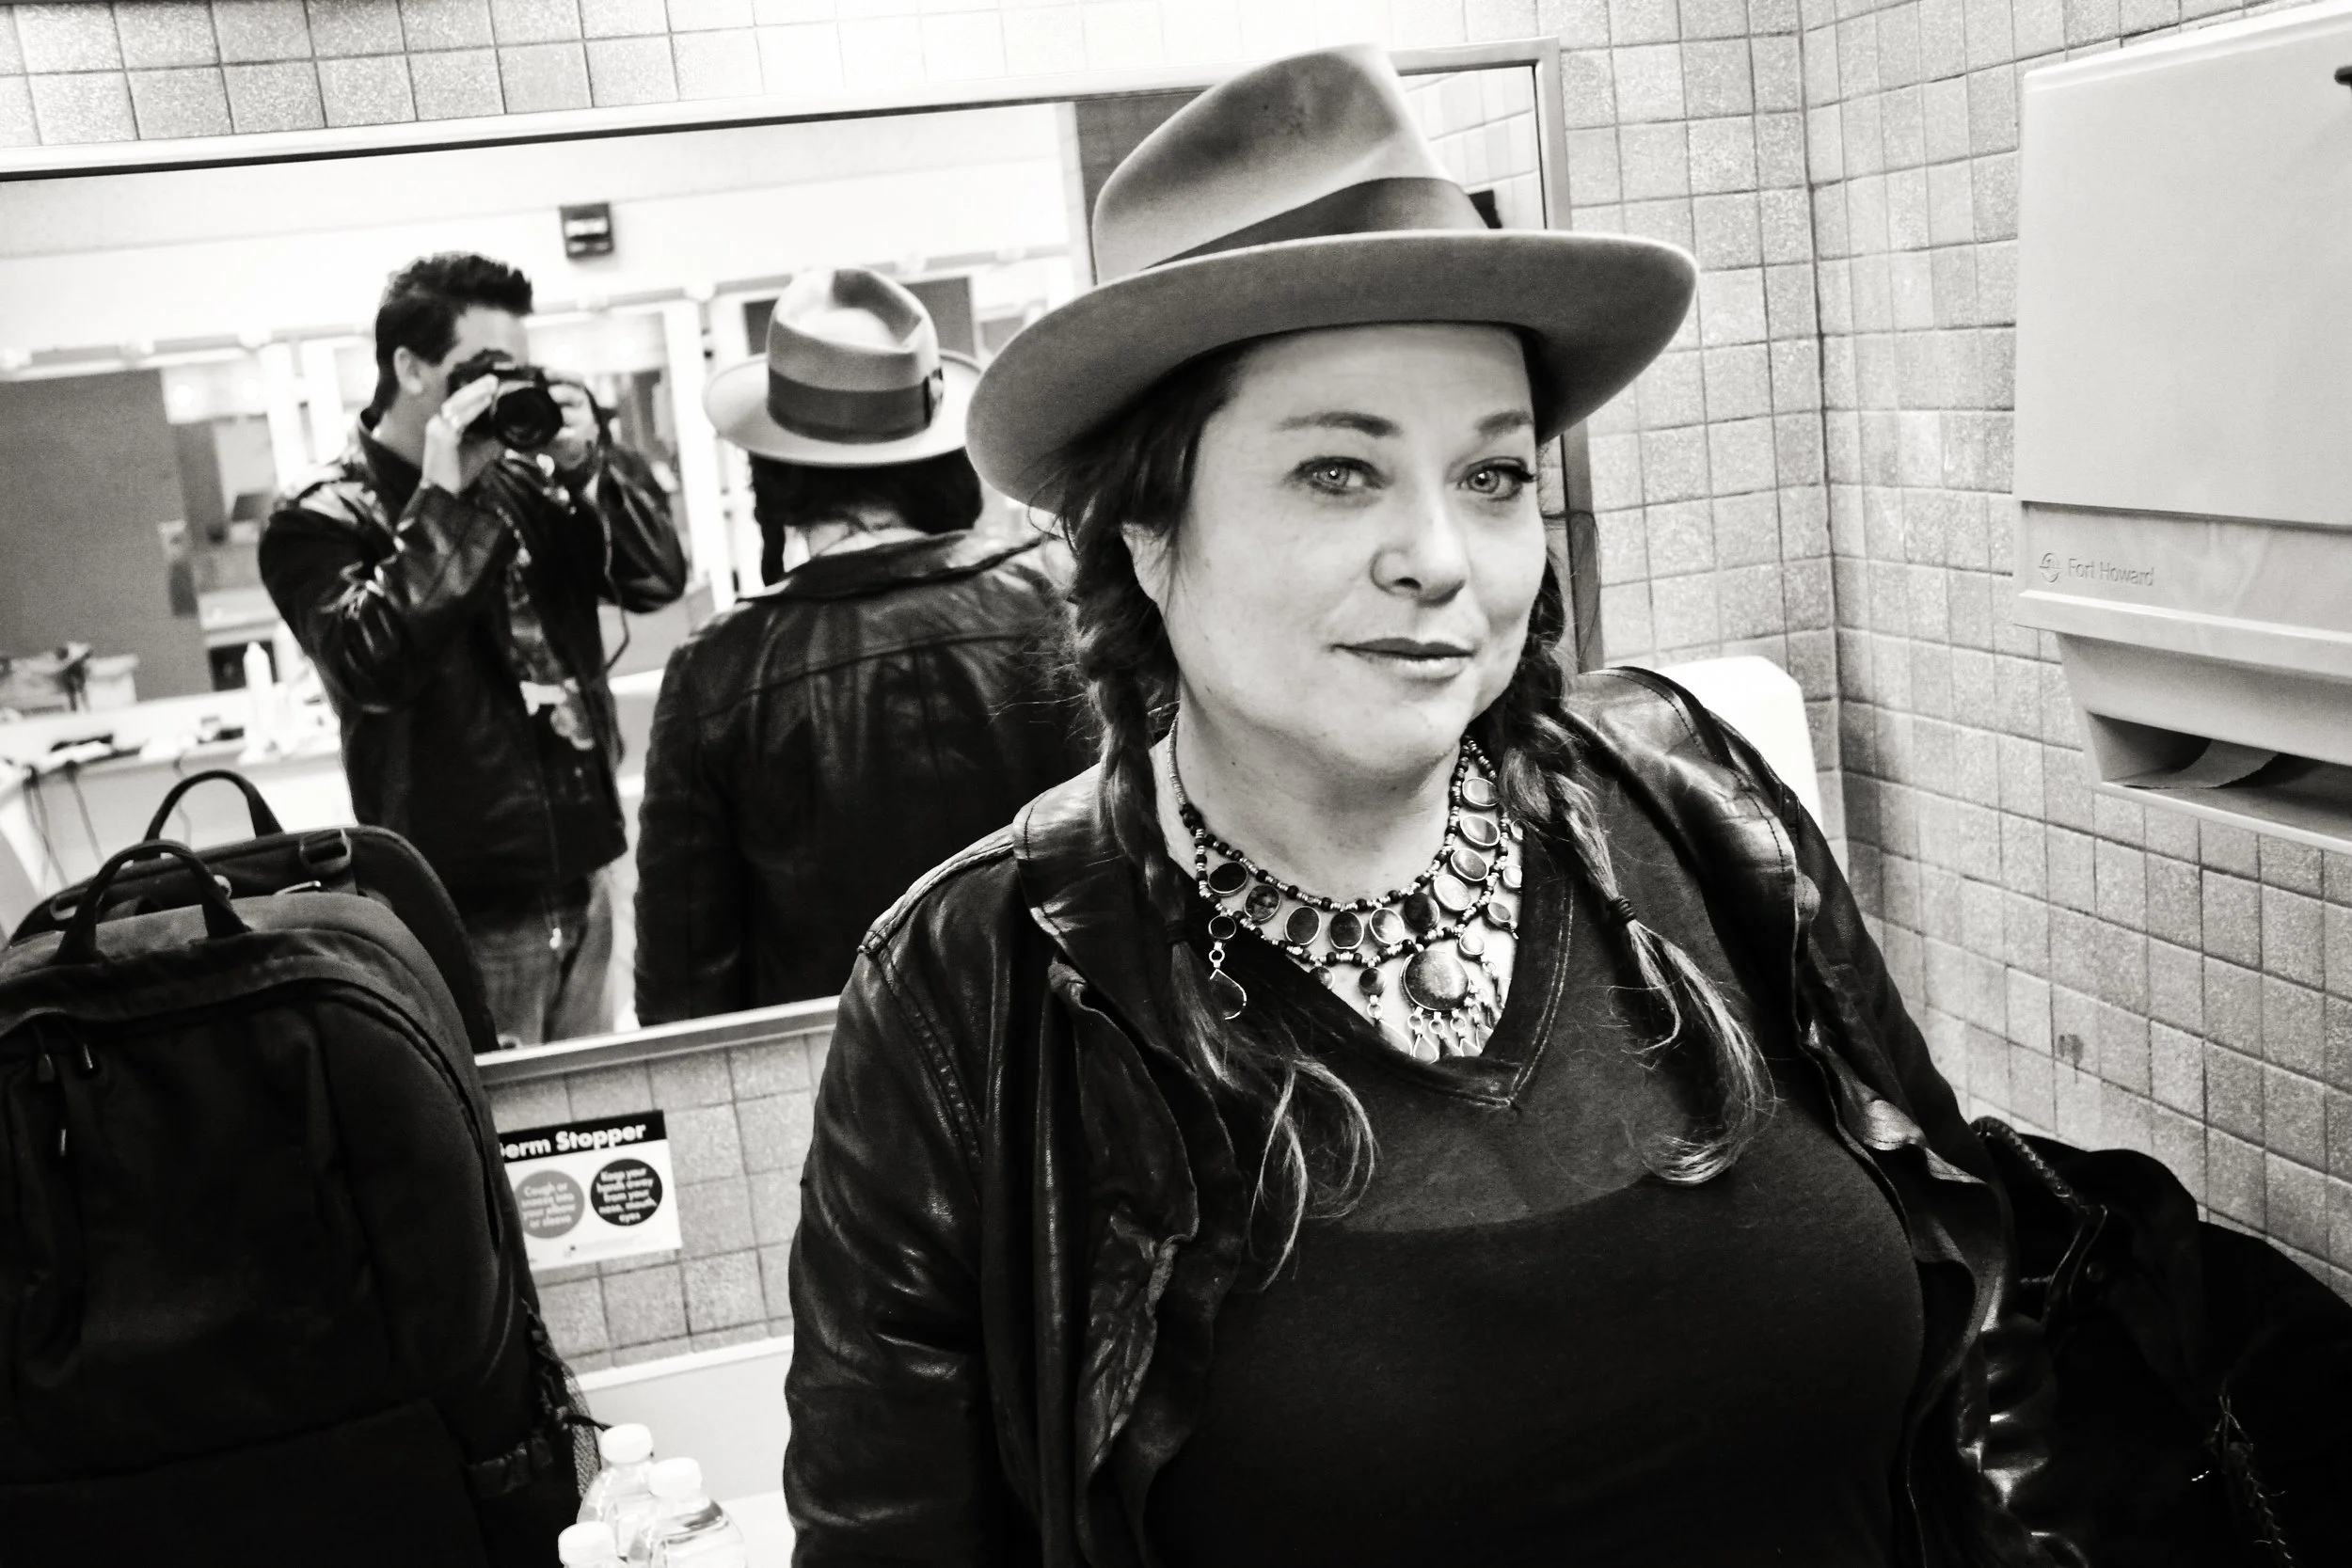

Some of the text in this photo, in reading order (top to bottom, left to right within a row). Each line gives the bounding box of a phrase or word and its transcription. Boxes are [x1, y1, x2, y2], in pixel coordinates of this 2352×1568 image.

[2069, 558, 2153, 586] Fort Howard
[500, 1124, 646, 1159] erm Stopper
